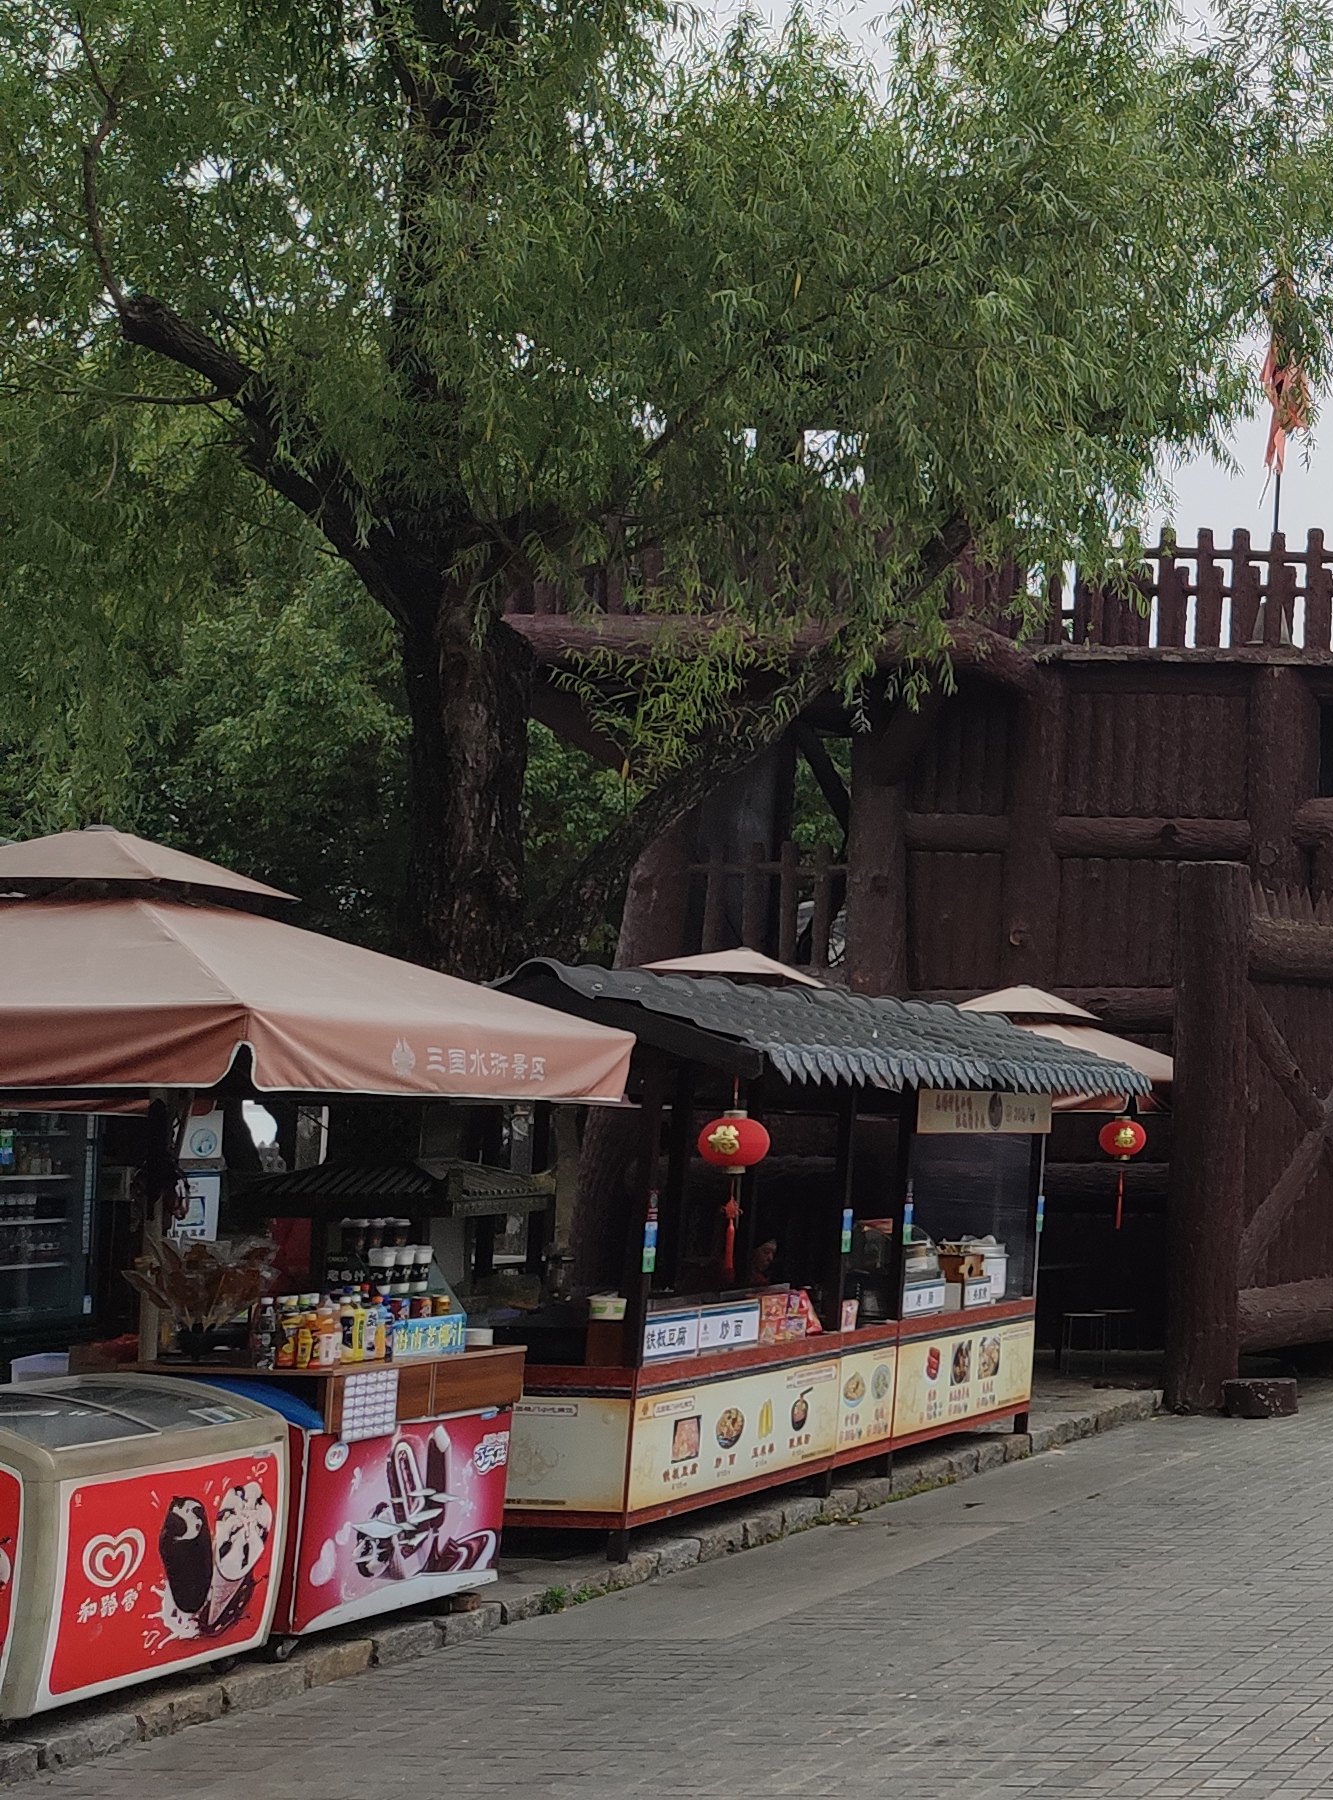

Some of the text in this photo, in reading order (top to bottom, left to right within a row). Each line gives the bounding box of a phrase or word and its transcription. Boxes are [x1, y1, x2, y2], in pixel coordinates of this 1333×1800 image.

[426, 1046, 547, 1082] 三国水浒景区
[646, 1325, 688, 1350] 铁板豆腐
[719, 1319, 744, 1340] 炒面
